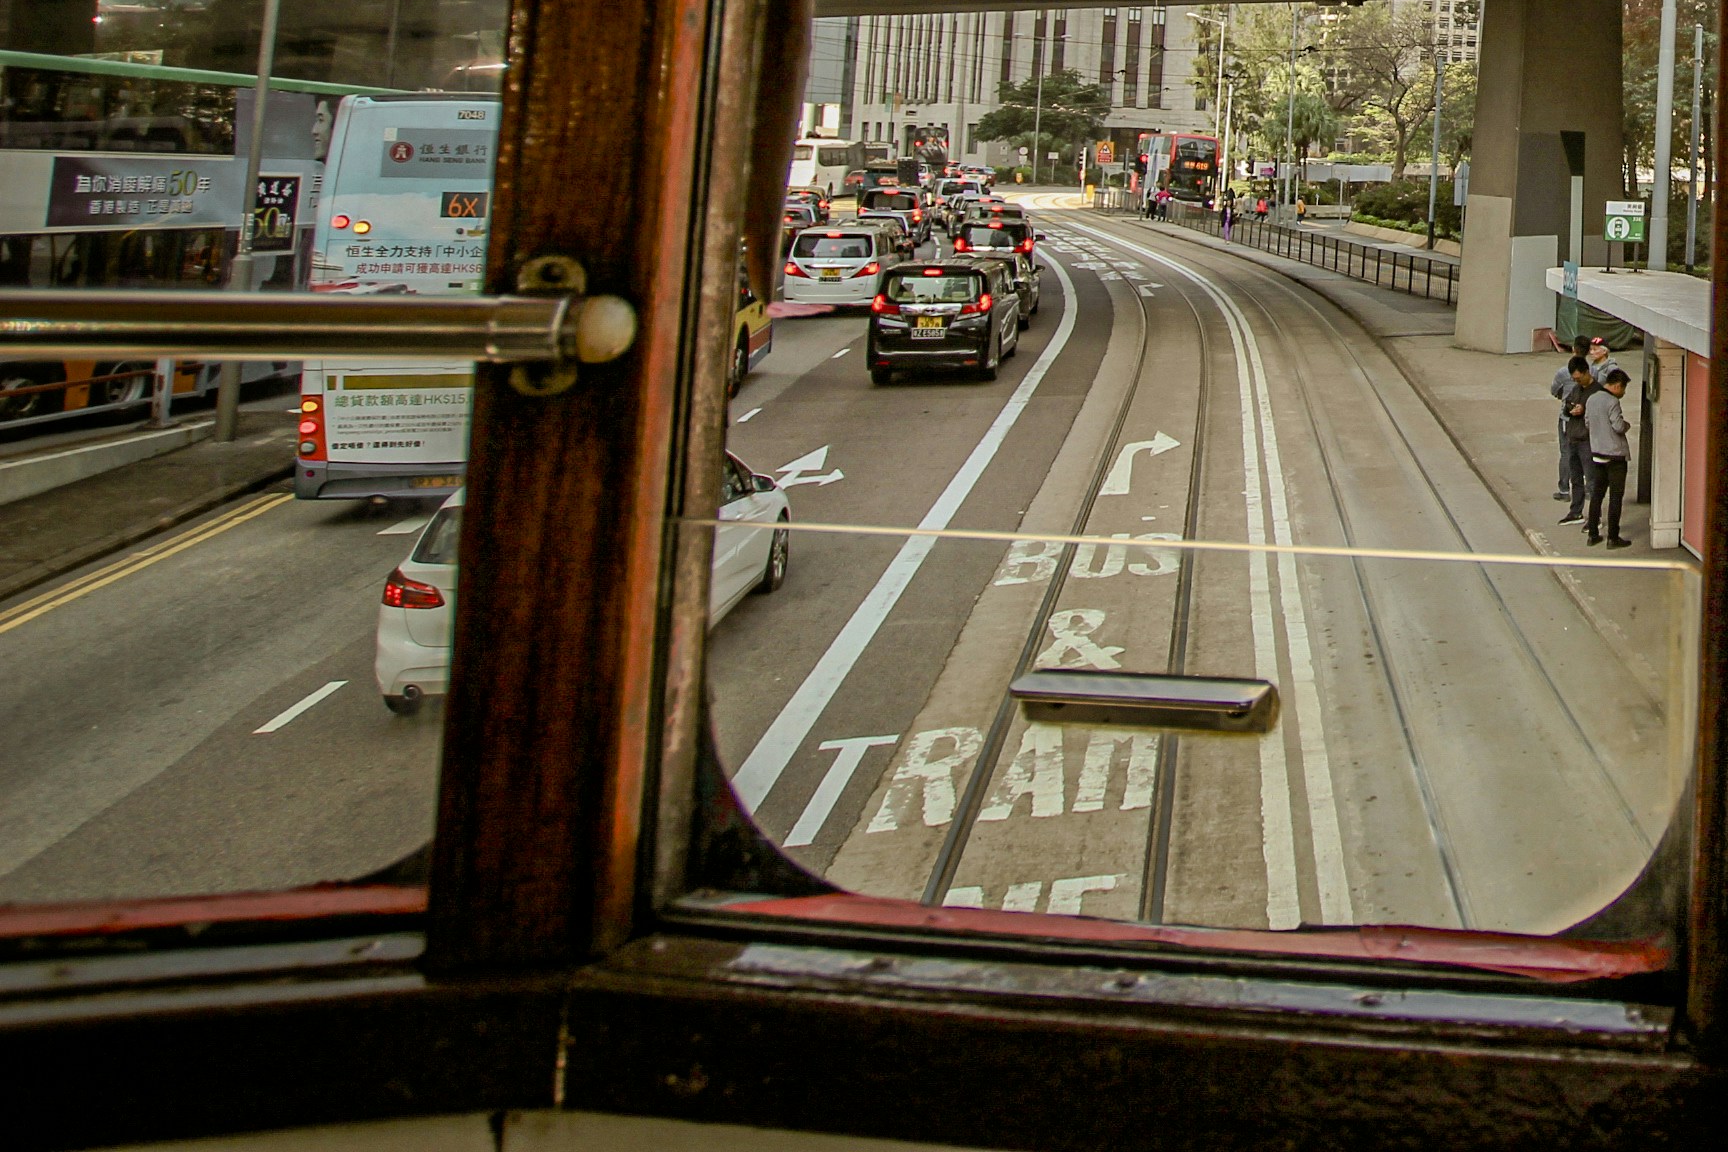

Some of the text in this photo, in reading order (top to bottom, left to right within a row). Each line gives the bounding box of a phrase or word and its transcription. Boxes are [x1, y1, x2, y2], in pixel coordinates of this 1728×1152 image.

[458, 110, 486, 120] 7048
[447, 193, 479, 217] 6X
[994, 532, 1184, 586] BUS
[1036, 608, 1126, 670] &
[783, 724, 1161, 848] TRAM
